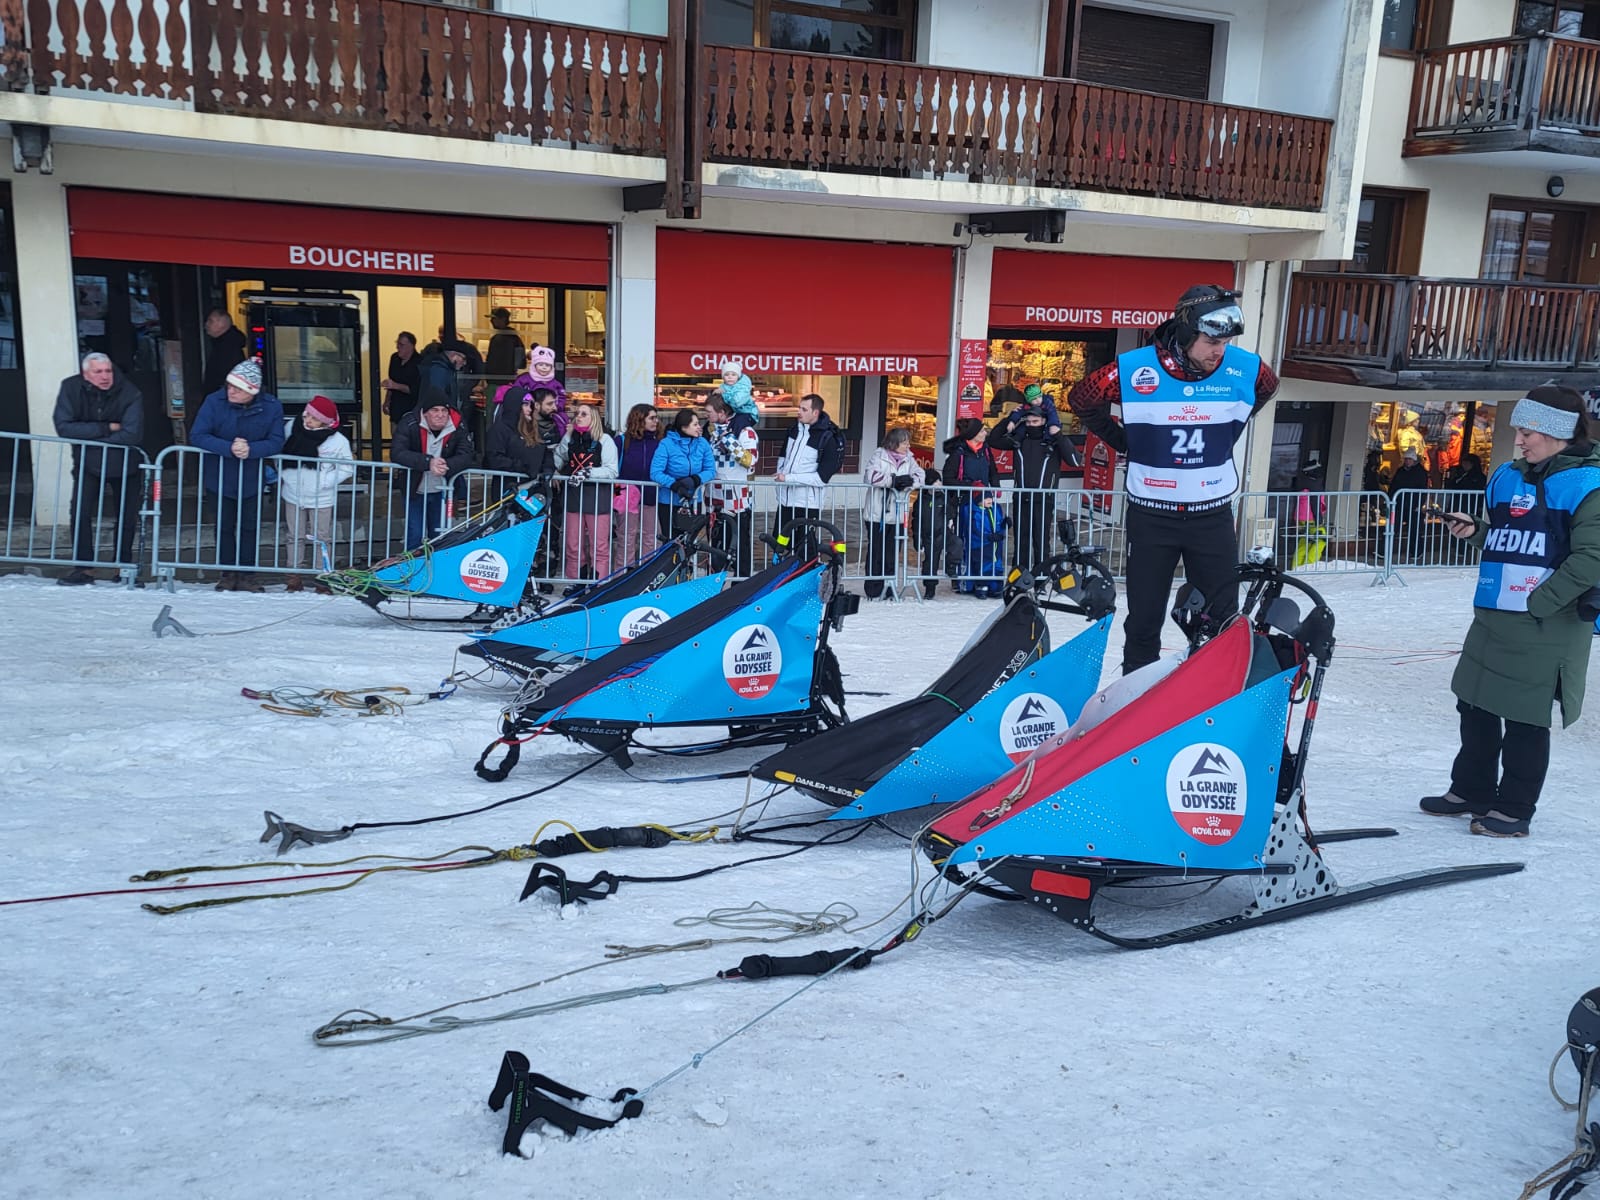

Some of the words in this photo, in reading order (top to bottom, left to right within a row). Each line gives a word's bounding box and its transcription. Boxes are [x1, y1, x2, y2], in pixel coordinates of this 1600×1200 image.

[289, 245, 435, 272] BOUCHERIE
[1025, 306, 1103, 324] PRODUITS
[835, 357, 919, 372] TRAITEUR
[1206, 384, 1231, 393] Région
[1171, 429, 1205, 454] 24
[1483, 524, 1546, 556] MÉDIA
[734, 653, 745, 662] LA
[746, 651, 772, 662] GRANDE
[1011, 726, 1021, 735] LA
[1022, 721, 1056, 735] GRANDE
[1180, 780, 1194, 792] LA
[1196, 781, 1238, 794] GRANDE
[1191, 826, 1213, 836] ROYAL
